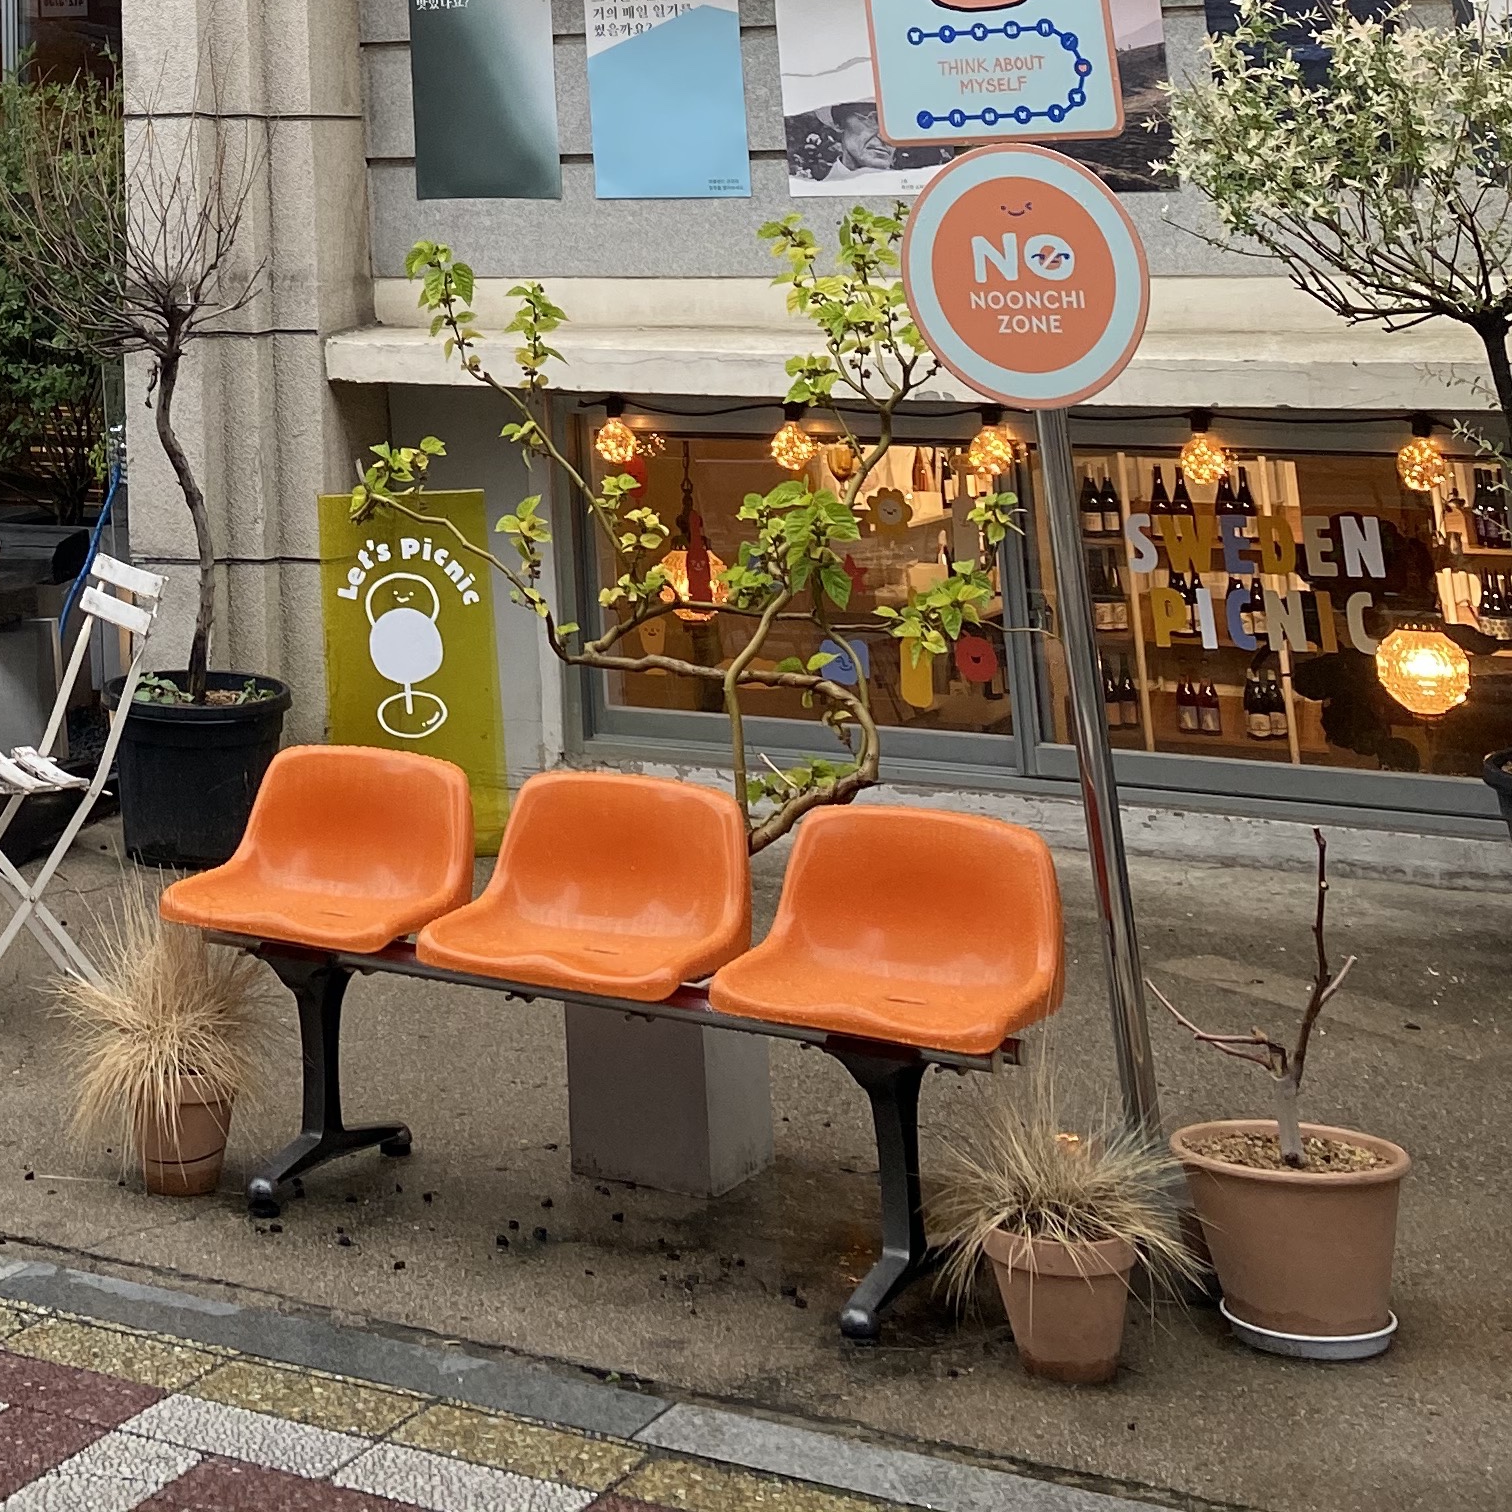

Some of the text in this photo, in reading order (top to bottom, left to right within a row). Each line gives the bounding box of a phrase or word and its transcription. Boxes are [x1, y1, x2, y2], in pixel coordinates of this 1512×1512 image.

[593, 5, 618, 20] 거의
[621, 4, 649, 19] 매일
[937, 55, 1046, 76] THINK ABOUT
[959, 76, 1028, 95] MYSELF
[970, 232, 1076, 284] NO
[968, 289, 1086, 310] NOONCHI
[997, 314, 1064, 334] ZONE
[1125, 512, 1387, 579] SWEDEN
[337, 537, 480, 606] Let's Picnic
[1149, 586, 1377, 656] PICNIC
